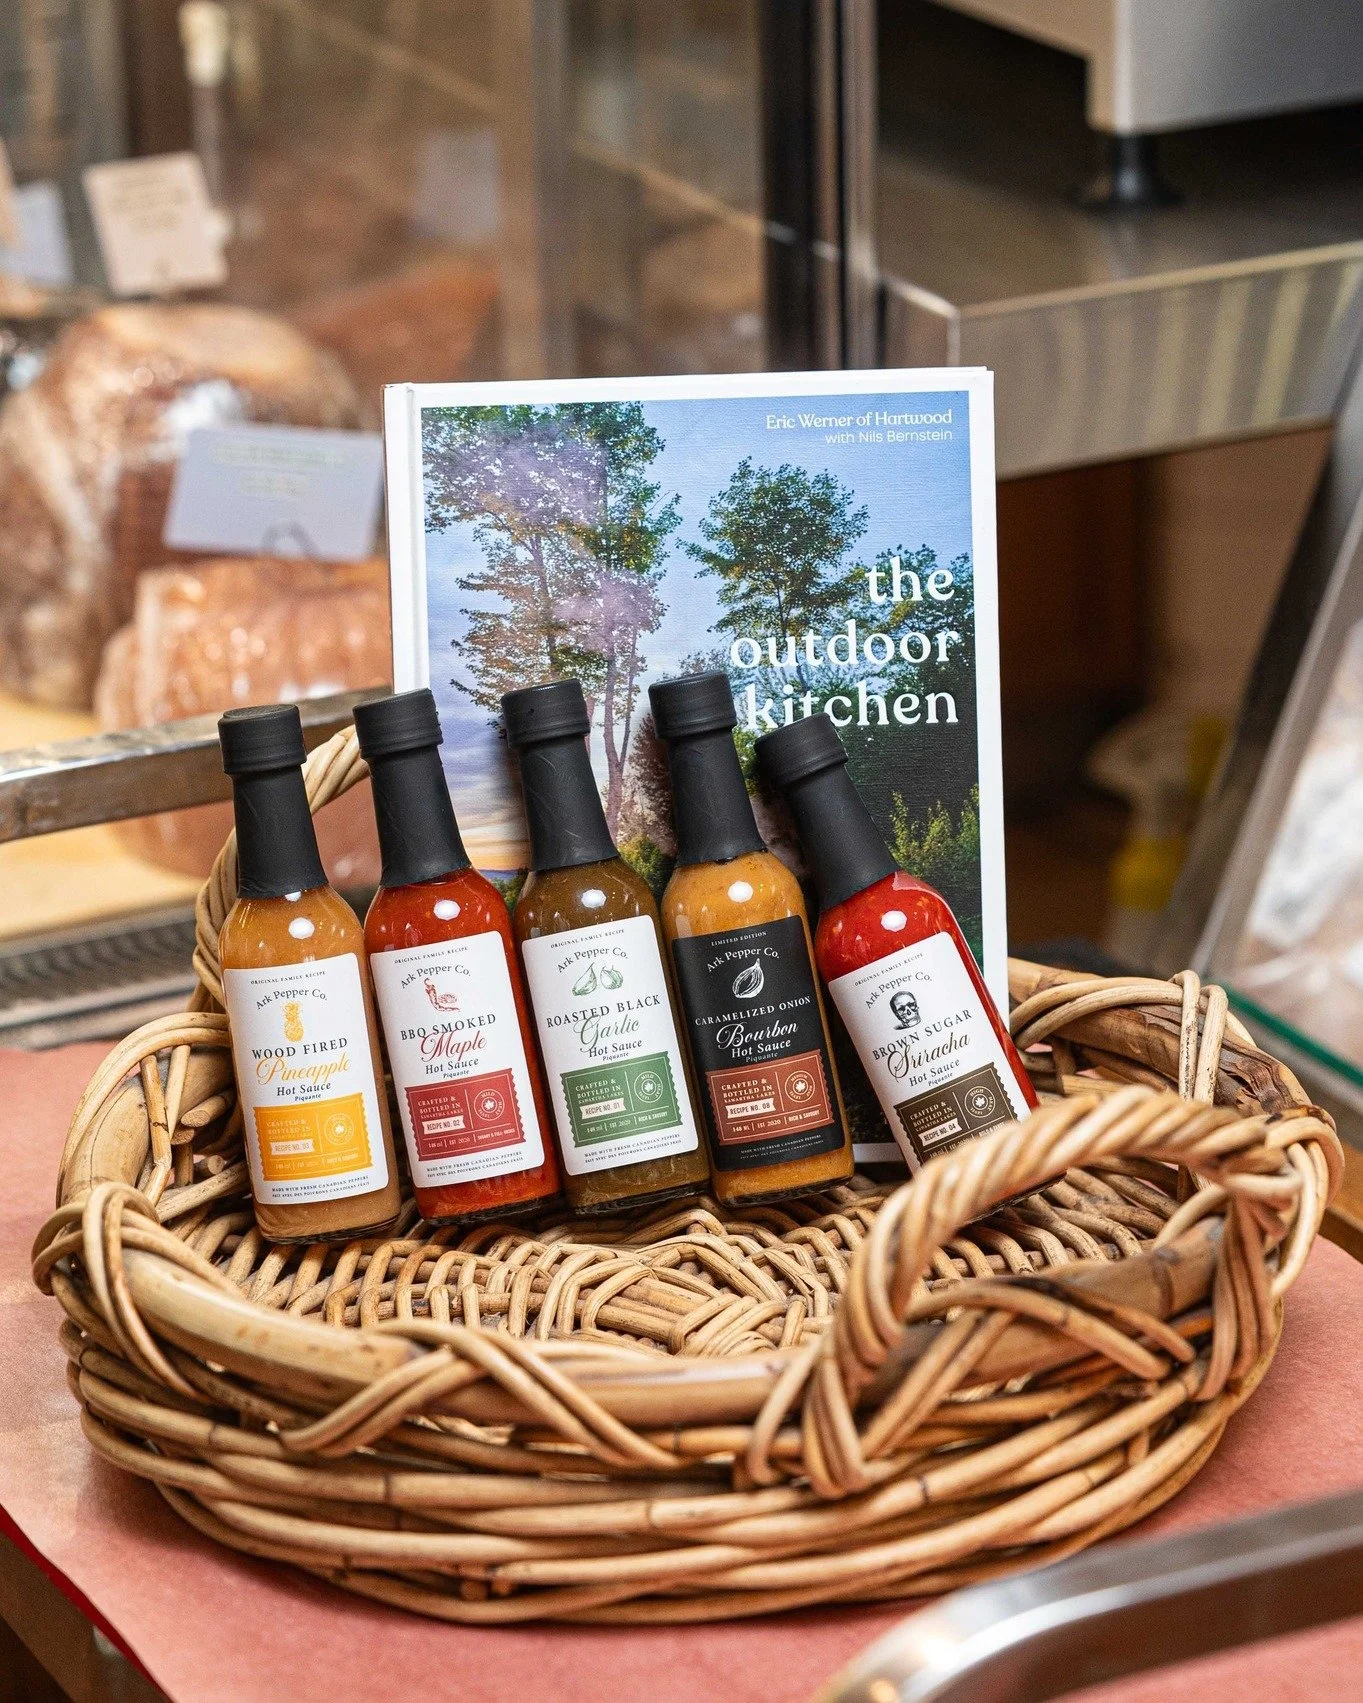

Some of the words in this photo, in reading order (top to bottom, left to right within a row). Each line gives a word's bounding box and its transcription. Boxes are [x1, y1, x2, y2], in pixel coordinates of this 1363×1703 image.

[766, 415, 795, 429] Eric
[799, 413, 854, 428] Werner
[856, 412, 873, 426] of
[875, 409, 952, 426] Hartwood
[825, 433, 855, 444] with
[859, 431, 883, 443] Nils
[887, 429, 952, 442] Bernstein
[865, 556, 954, 604] the
[730, 619, 958, 669] outdoor
[745, 680, 959, 729] kitchen
[711, 937, 738, 946] LIMITED
[740, 931, 766, 940] EDITION
[557, 957, 573, 972] Ark
[574, 948, 609, 960] Pepper
[613, 947, 628, 958] Co.
[707, 956, 724, 972] Ark
[725, 949, 761, 960] Pepper
[764, 947, 779, 958] Co.
[401, 973, 416, 988] Ark
[416, 965, 452, 977] Pepper
[455, 964, 470, 976] Co.
[256, 995, 272, 1009] Ark
[273, 989, 309, 999] Pepper
[312, 989, 327, 1000] Co.
[865, 992, 879, 1008] Ark
[878, 975, 912, 992] Pepper
[915, 971, 932, 981] Co.
[546, 1005, 610, 1027] ROASTED
[617, 994, 660, 1012] BLACK
[695, 1005, 775, 1025] CARAMELIZED
[778, 996, 811, 1010] ONION
[400, 1027, 426, 1041] BBQ
[432, 1013, 496, 1035] SMOKED
[573, 1014, 641, 1052] Garlic
[716, 1020, 798, 1049] Bourbon
[872, 1032, 920, 1060] BROWN
[923, 1009, 971, 1036] SUGAR
[251, 1047, 296, 1060] WOOD
[302, 1037, 348, 1054] FIRED
[419, 1028, 486, 1062] Maple
[588, 1045, 608, 1058] Hot
[611, 1038, 643, 1053] Sauce
[730, 1045, 753, 1058] Hot
[756, 1038, 791, 1053] Sauce
[425, 1063, 444, 1074] Hot
[446, 1056, 479, 1070] Sauce
[602, 1051, 629, 1062] Piquante
[745, 1051, 778, 1063] Piquante
[885, 1032, 970, 1083] Sriracha
[255, 1052, 350, 1087] Pineapple
[442, 1070, 469, 1078] Piquante
[908, 1072, 928, 1086] Hot
[929, 1057, 961, 1077] Sauce
[927, 1071, 953, 1086] Piquante
[275, 1085, 295, 1096] Hot
[299, 1081, 331, 1093] Sauce
[575, 1080, 608, 1092] CRAFTED
[577, 1087, 610, 1099] BOTTLED
[721, 1079, 758, 1091] CRAFTED
[722, 1086, 760, 1099] BOTTLED
[970, 1088, 984, 1096] HIGH
[294, 1093, 321, 1102] Piquante
[417, 1097, 448, 1107] CRAFTED
[419, 1104, 450, 1114] BOTTLED
[585, 1106, 602, 1115] RECIPE
[730, 1106, 749, 1115] RECIPE
[909, 1104, 939, 1120] CRAFTED
[426, 1122, 442, 1131] RECIPE
[913, 1111, 942, 1127] BOTTLED
[923, 1130, 940, 1141] RECIPE
[948, 1123, 956, 1131] 04
